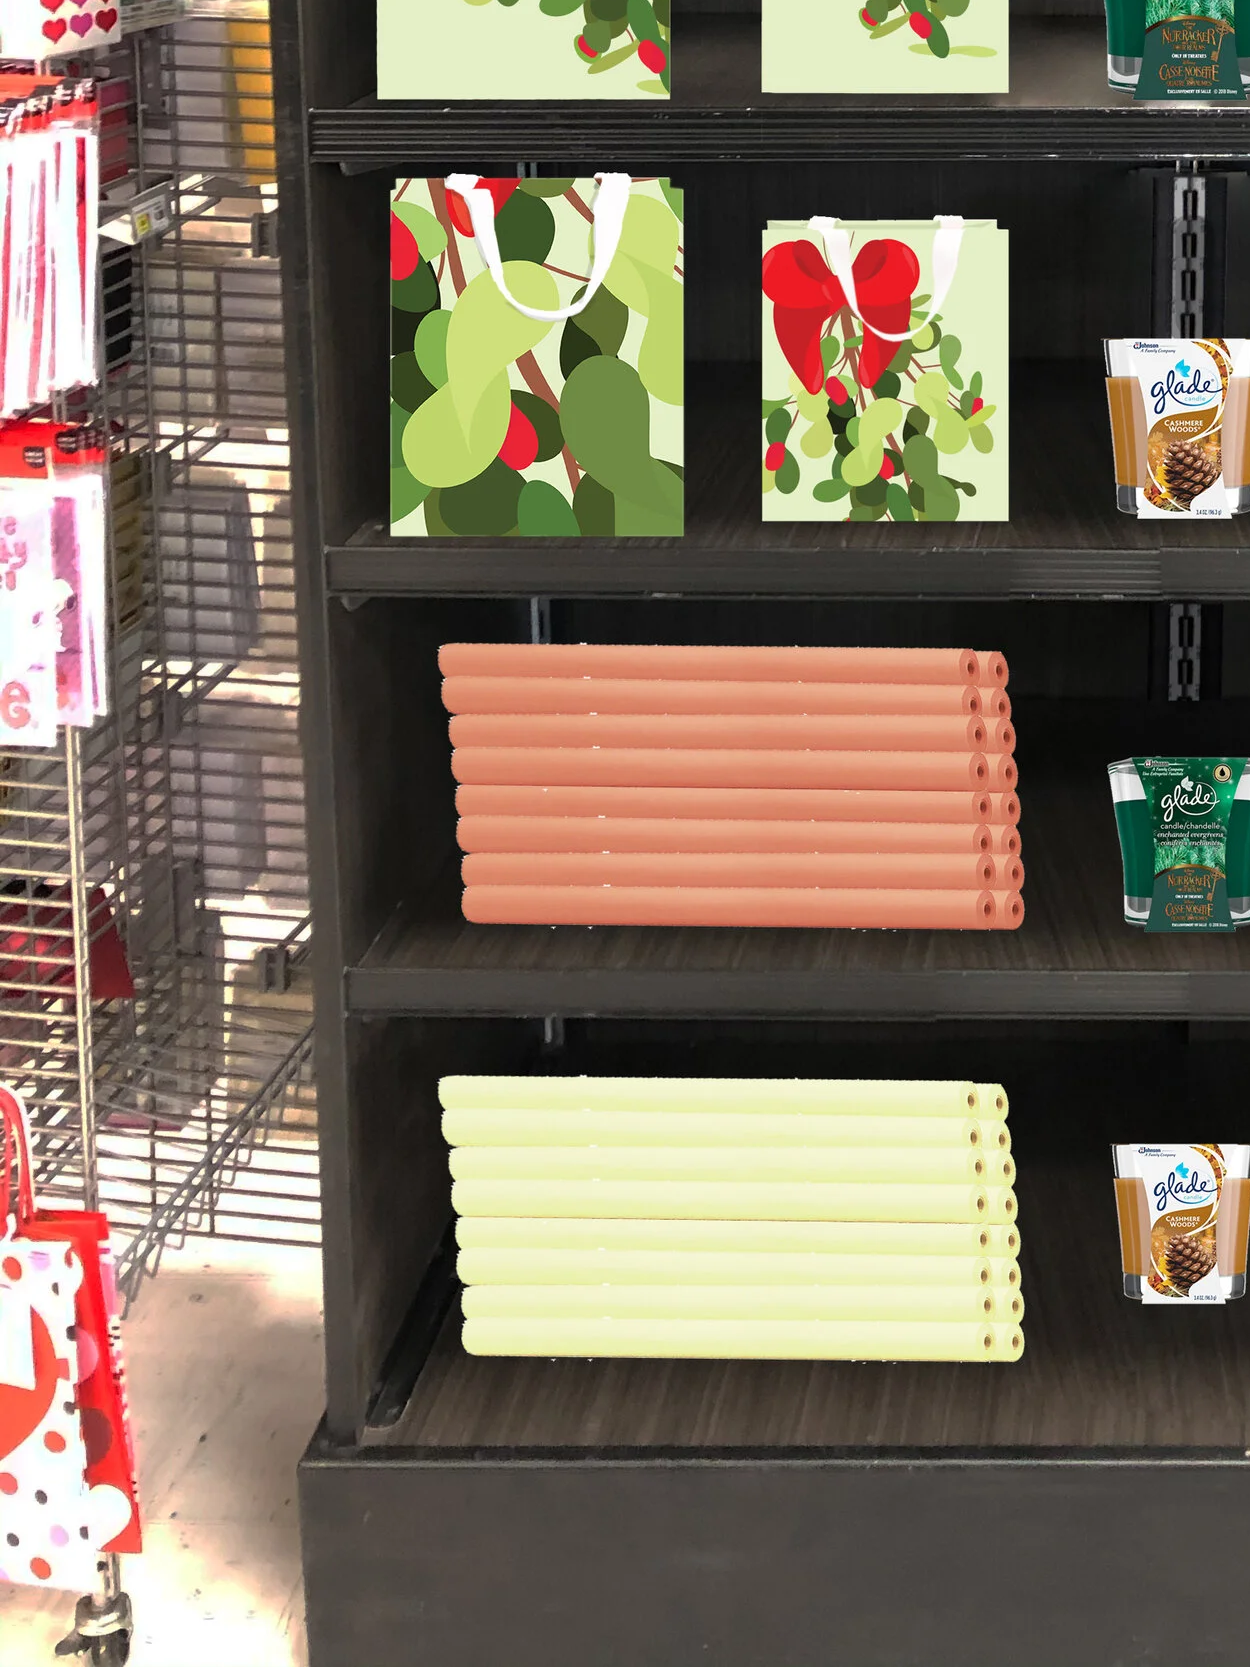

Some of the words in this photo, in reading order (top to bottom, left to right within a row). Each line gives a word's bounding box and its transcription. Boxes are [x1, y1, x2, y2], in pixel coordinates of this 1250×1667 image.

[1151, 369, 1222, 414] glade
[1161, 784, 1220, 822] glade
[1154, 1171, 1217, 1211] glade
